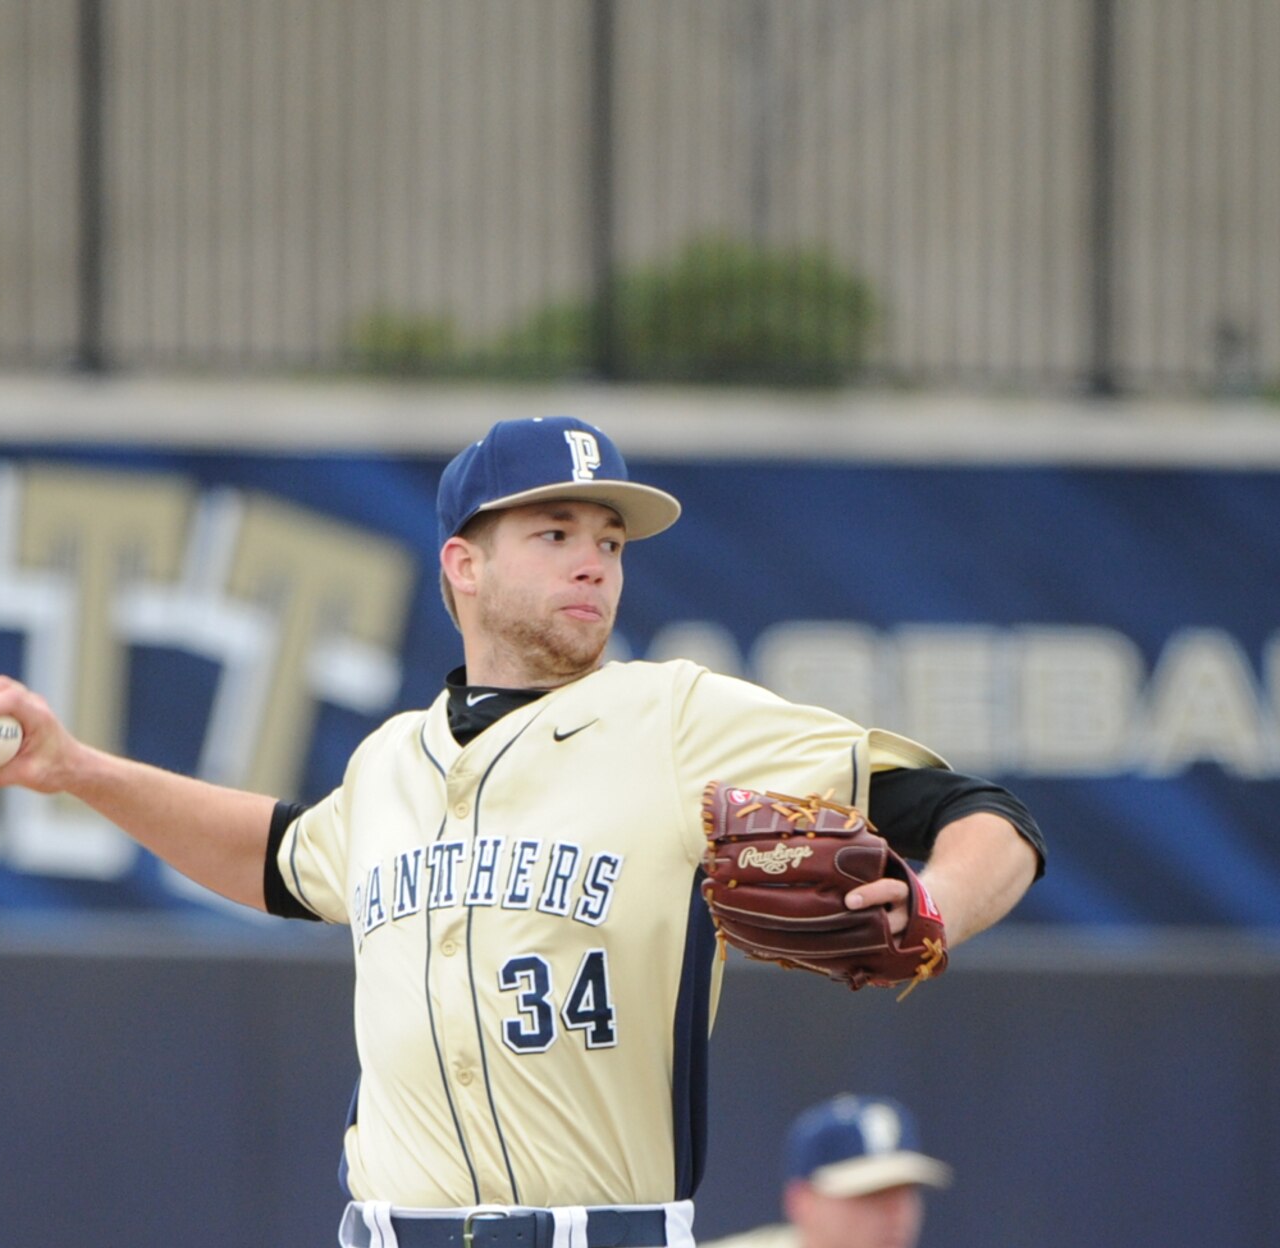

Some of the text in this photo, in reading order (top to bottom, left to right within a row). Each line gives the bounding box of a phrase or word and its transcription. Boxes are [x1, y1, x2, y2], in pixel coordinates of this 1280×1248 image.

[564, 430, 601, 482] P
[738, 843, 813, 869] Rawlings
[498, 947, 619, 1055] 34
